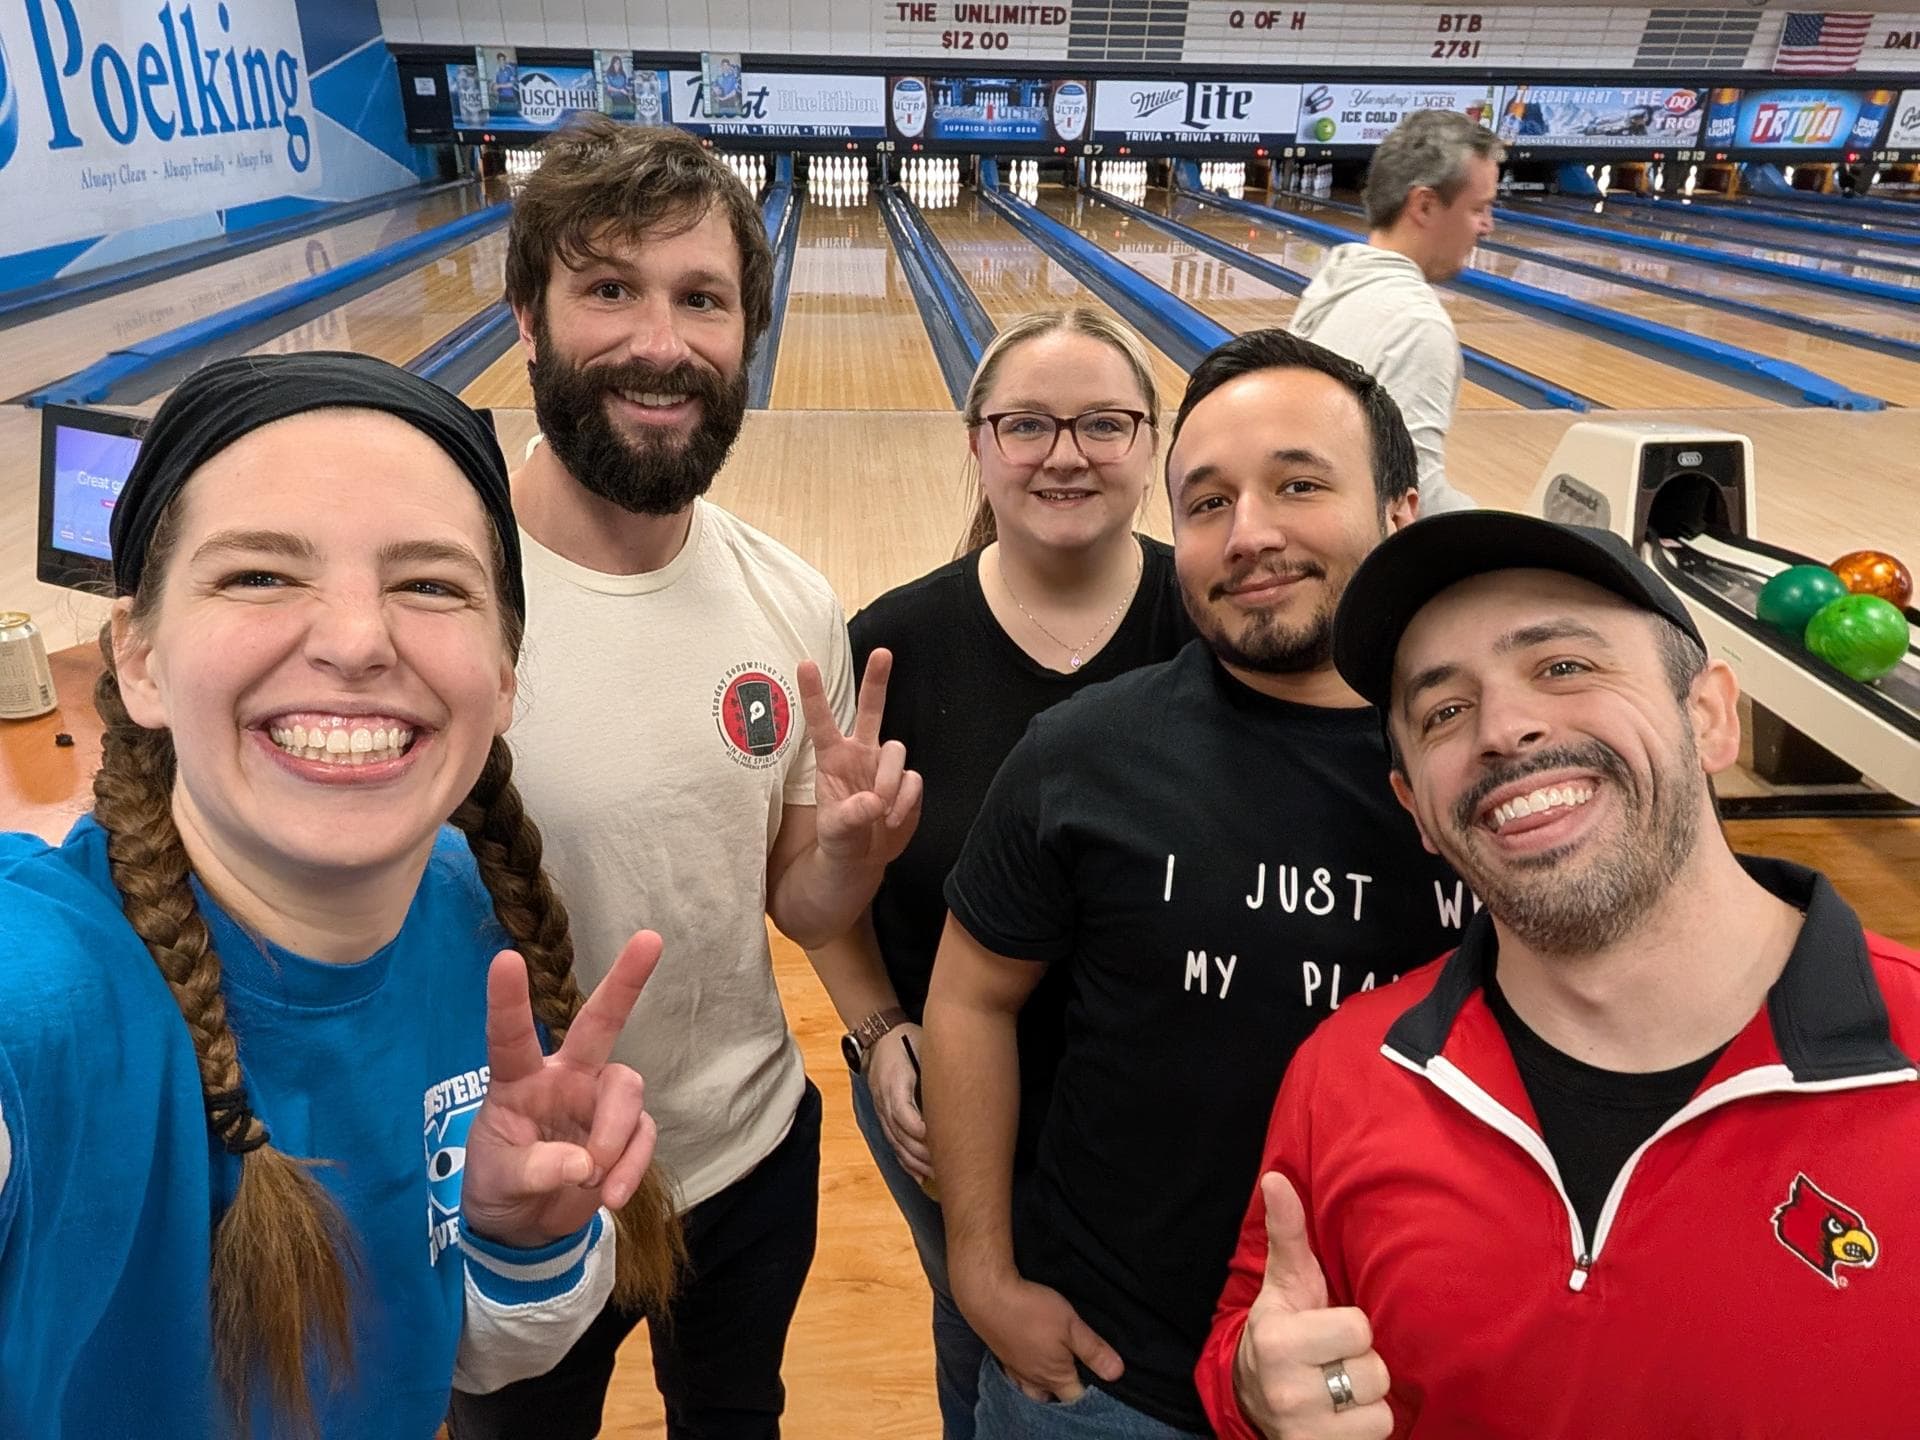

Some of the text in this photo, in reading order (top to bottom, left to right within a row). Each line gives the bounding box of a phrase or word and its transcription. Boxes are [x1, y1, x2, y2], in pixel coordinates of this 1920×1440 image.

[897, 3, 1067, 25] THE UNLIMITED
[1229, 10, 1306, 30] Q OF H
[1437, 14, 1482, 33] BTB
[1431, 40, 1480, 58] 2781
[25, 0, 310, 173] Poelking
[894, 101, 926, 111] ULTRA
[1130, 82, 1253, 129] Miller Lite
[1414, 96, 1456, 108] LAGER
[1516, 89, 1664, 105] TUESDAY NIGHT THE
[1669, 95, 1692, 109] DQ
[524, 107, 556, 116] LIGHT
[1055, 105, 1085, 115] ULTRA
[1341, 111, 1362, 123] ICE
[1365, 111, 1398, 123] COLD
[710, 124, 851, 137] TRIVIA TRIVIA TRIVIA
[944, 124, 985, 132] SUPERIOR
[1654, 117, 1695, 130] TRIO
[1754, 108, 1841, 139] TRIVIA
[1126, 132, 1260, 143] TRIVIA TRIVIA TRIVIA
[119, 163, 147, 185] Clean
[711, 660, 797, 718] Sunday Songwriter Series
[1163, 854, 1484, 930] I JUST W
[1184, 950, 1238, 1000] MY
[424, 1065, 491, 1120] STERS
